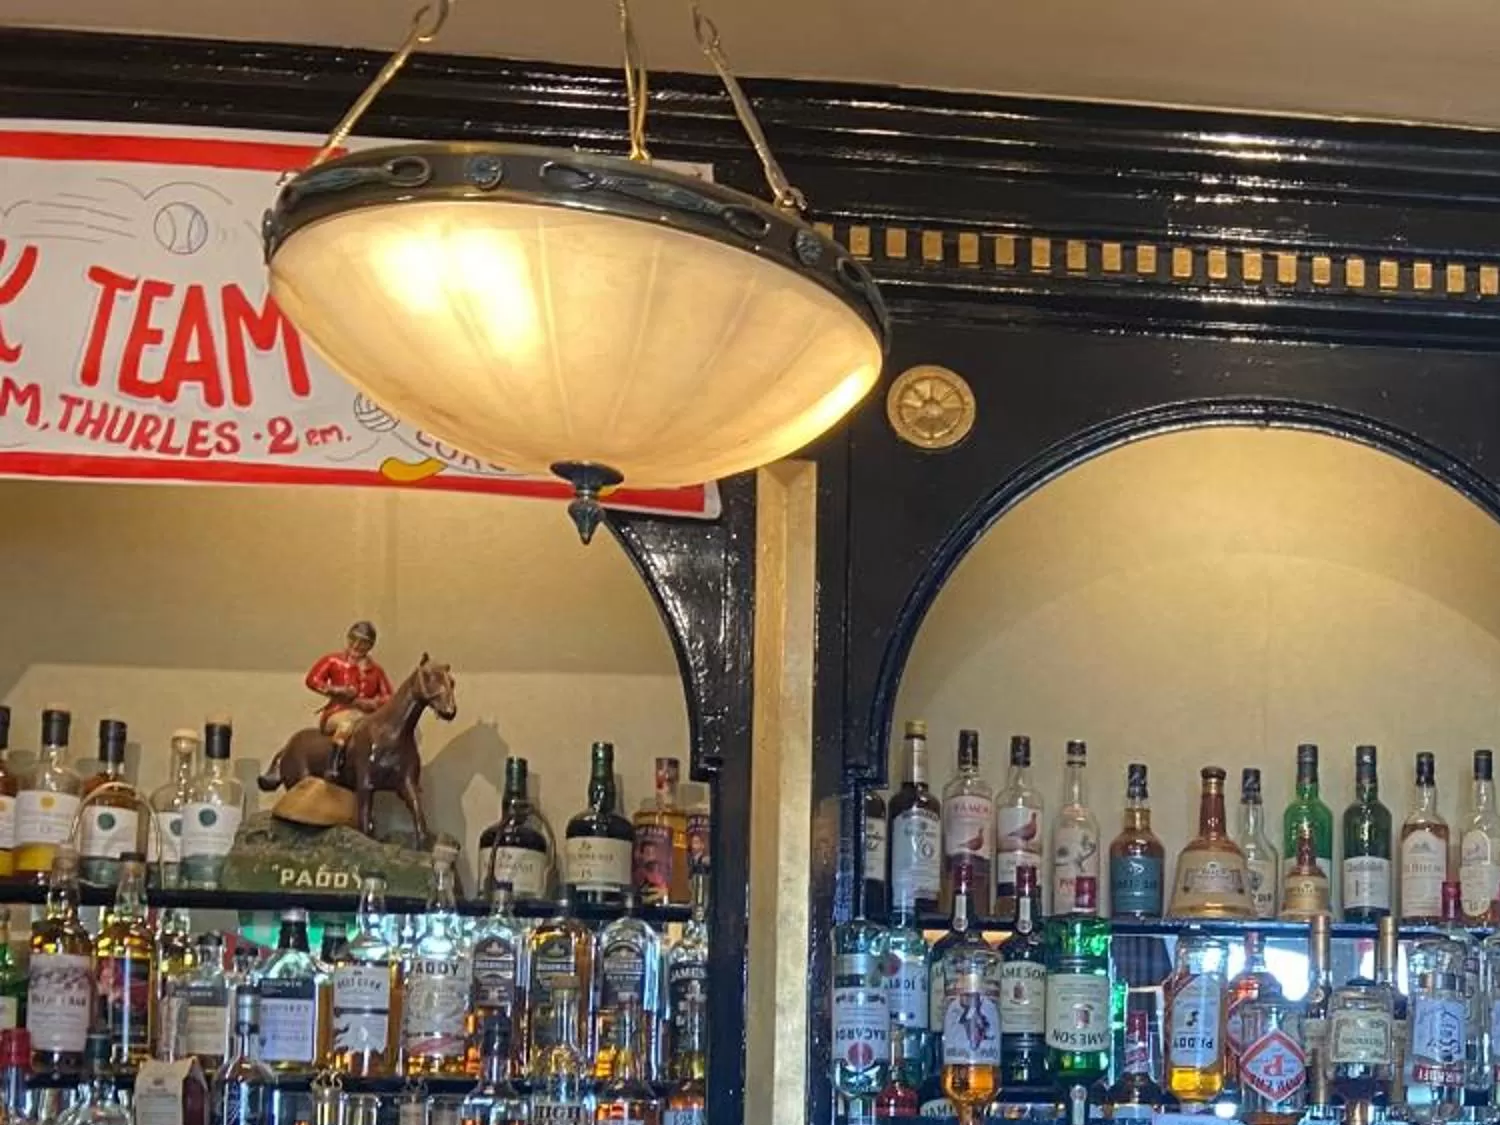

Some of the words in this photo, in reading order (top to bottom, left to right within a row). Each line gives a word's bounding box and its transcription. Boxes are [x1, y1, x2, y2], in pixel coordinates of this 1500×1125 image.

[80, 265, 311, 408] TEAM
[58, 393, 241, 458] THURLES
[267, 416, 300, 455] 2
[1051, 1029, 1109, 1047] AMESON
